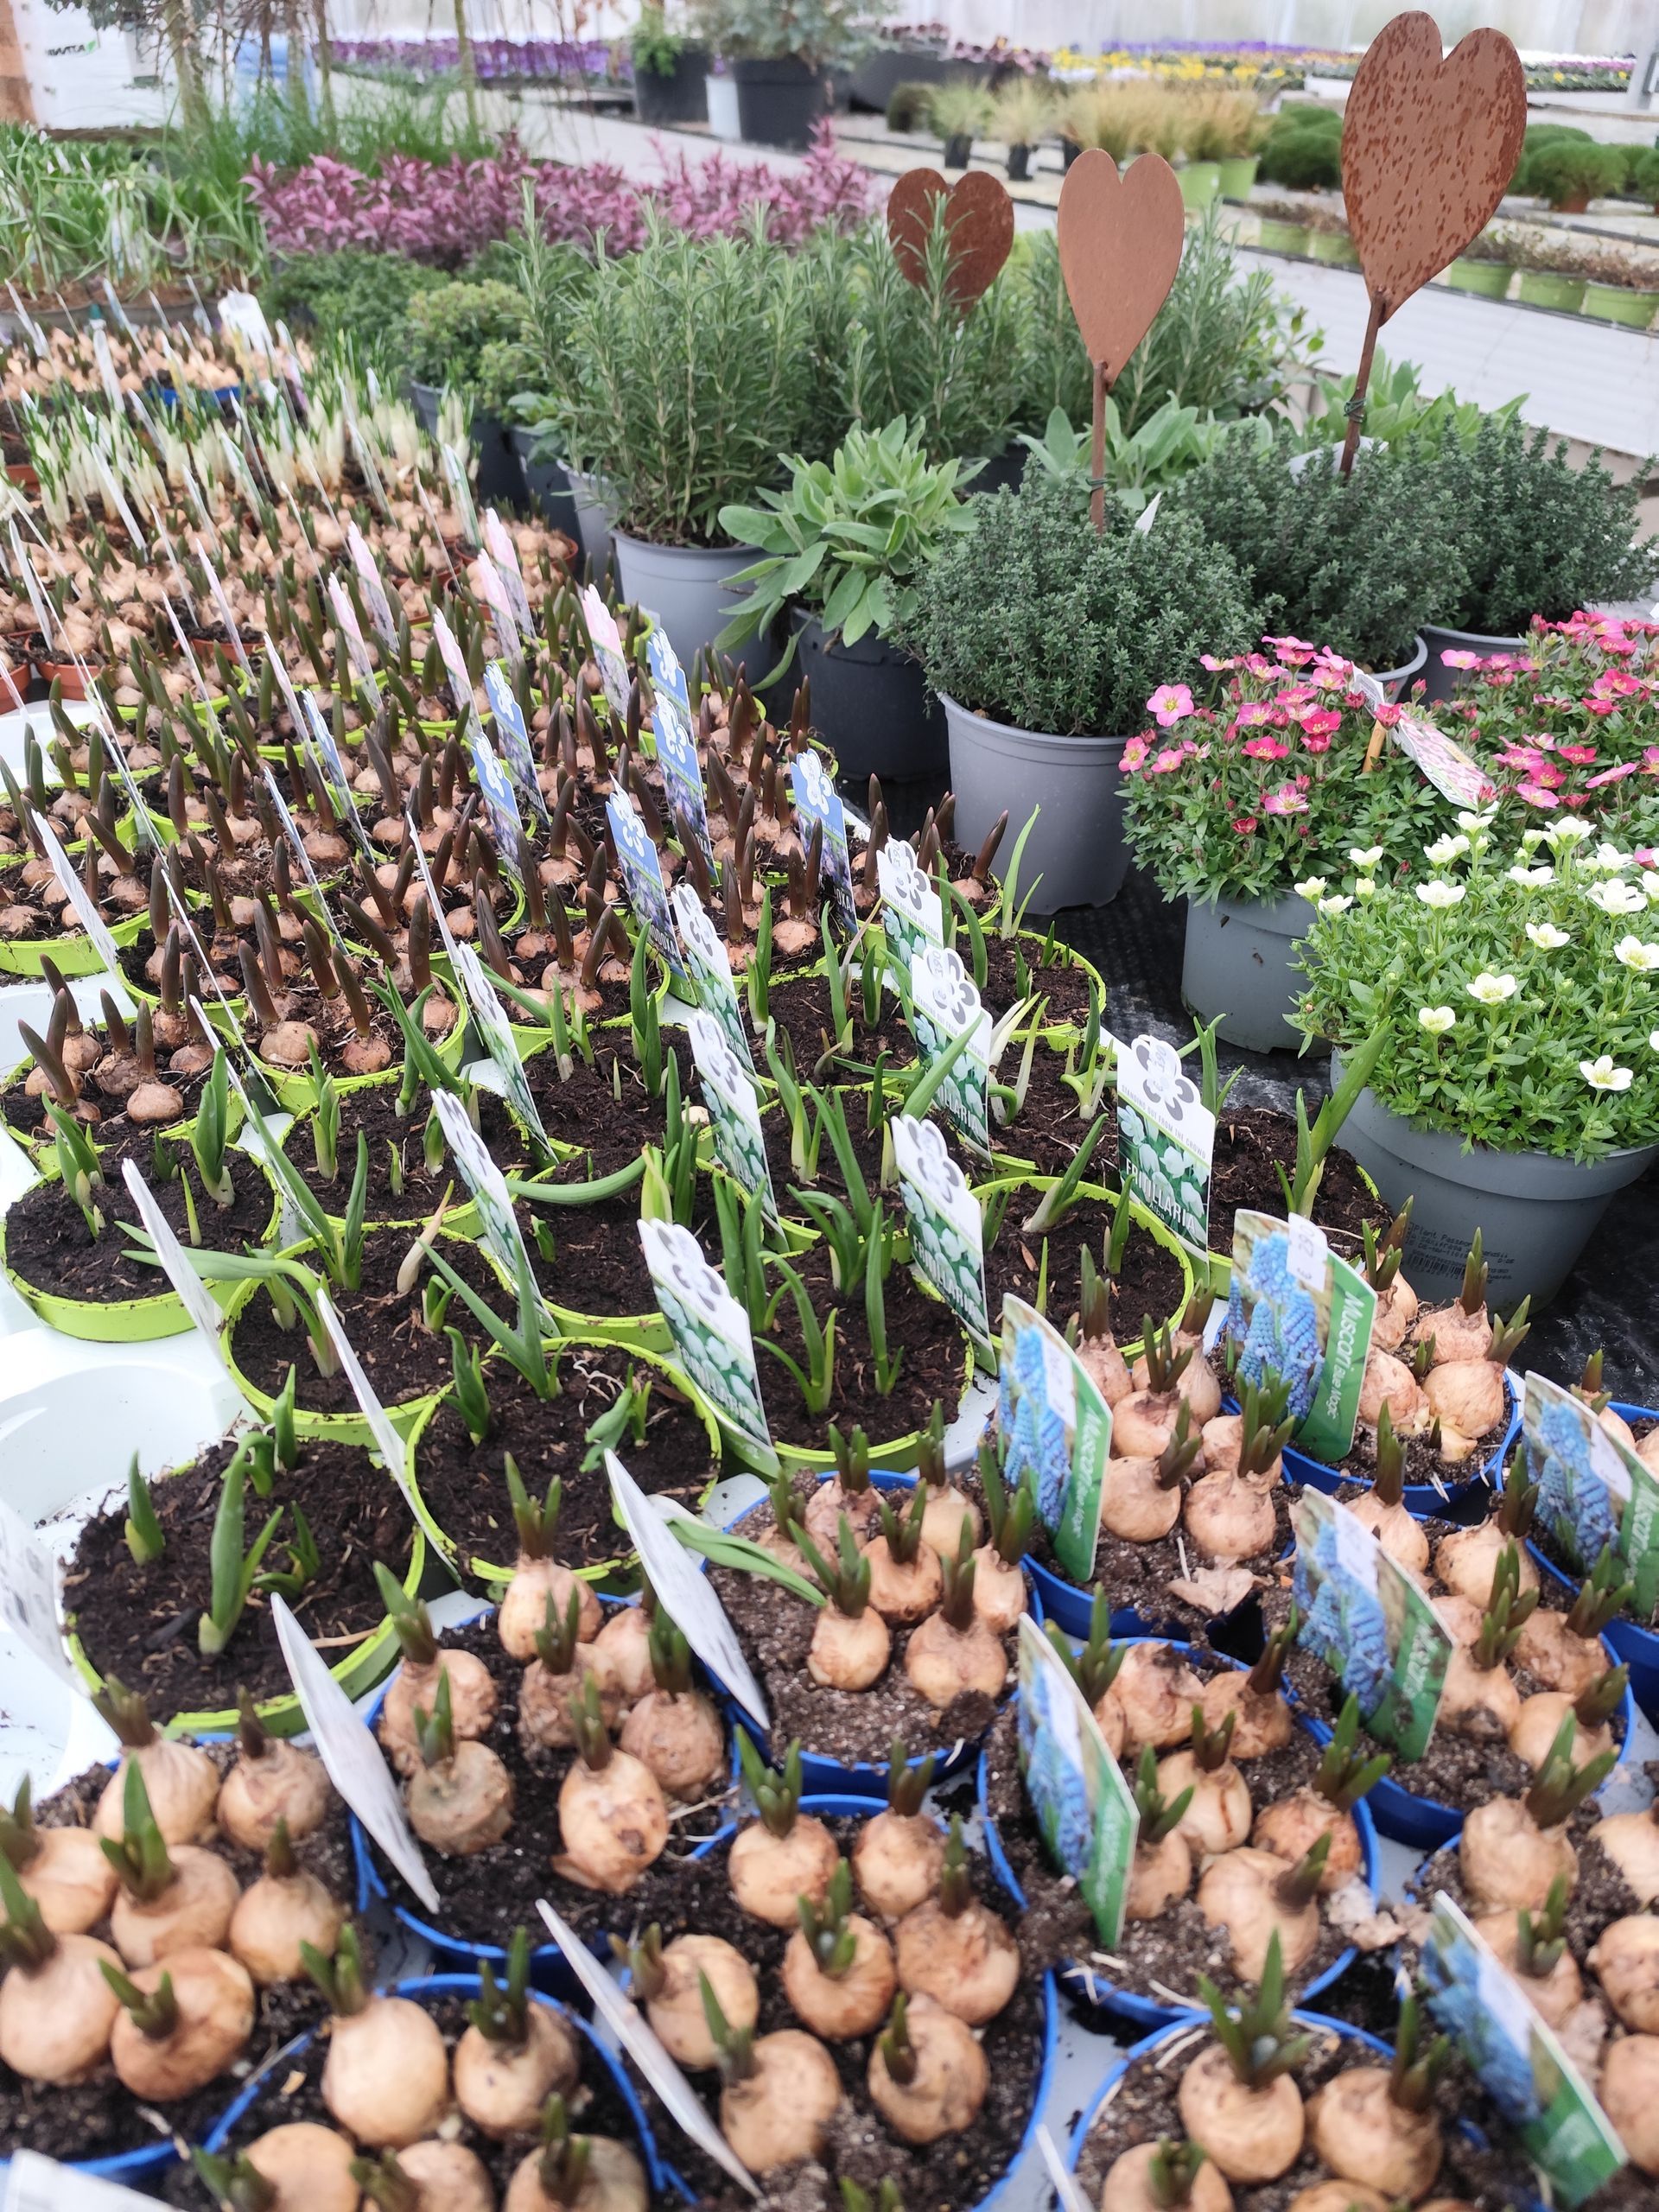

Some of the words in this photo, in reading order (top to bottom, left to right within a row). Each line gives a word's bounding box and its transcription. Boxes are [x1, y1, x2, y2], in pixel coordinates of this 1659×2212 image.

[1159, 1116, 1173, 1133] FROM
[1413, 1224, 1438, 1240] Plant
[1441, 1233, 1473, 1247] Passpor
[1336, 1291, 1365, 1372] Muscari
[1325, 1387, 1342, 1421] Magic
